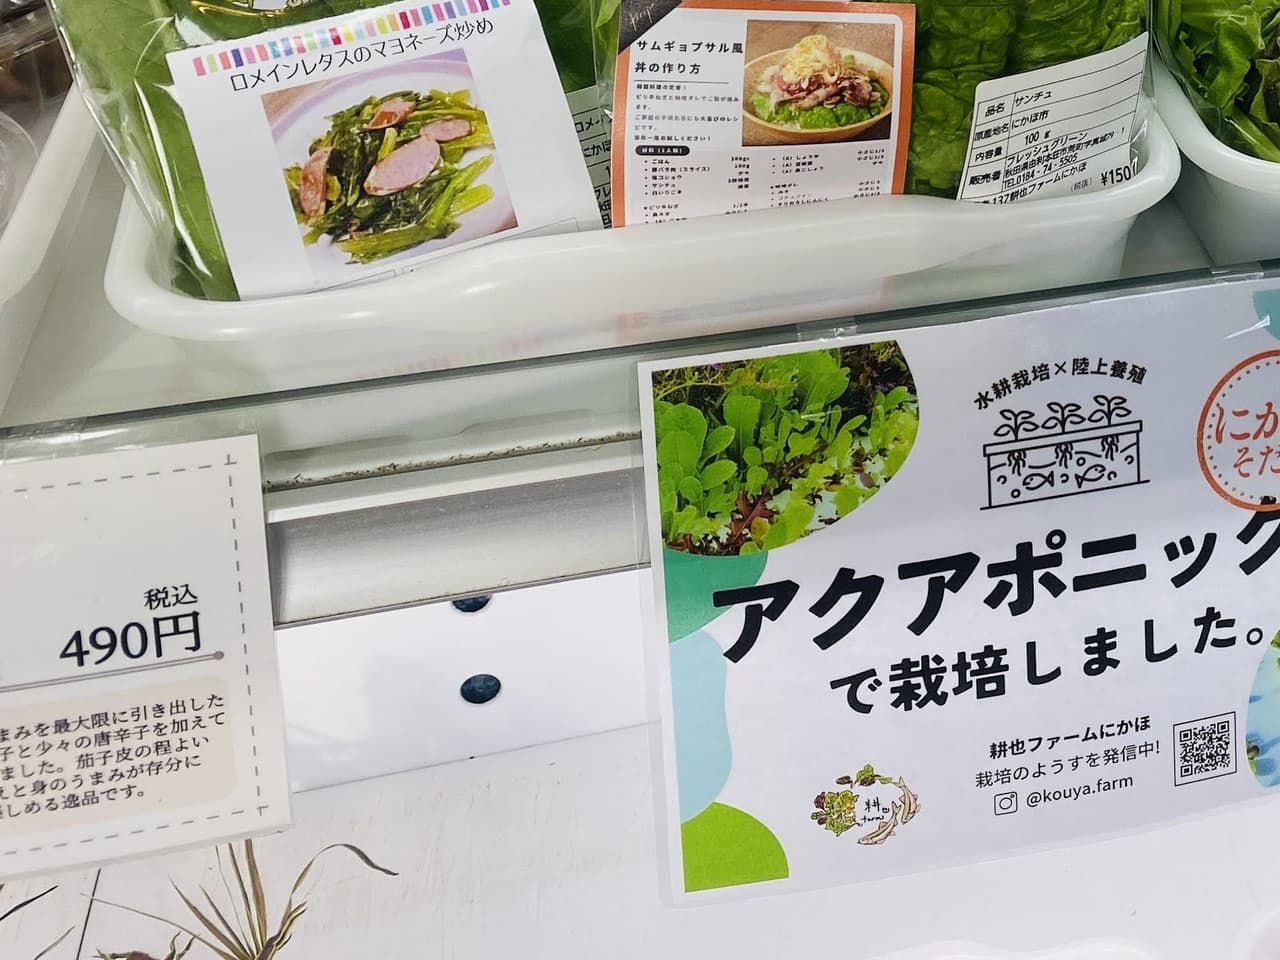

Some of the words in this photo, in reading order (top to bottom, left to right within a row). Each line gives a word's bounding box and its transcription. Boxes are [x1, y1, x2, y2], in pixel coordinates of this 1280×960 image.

[230, 17, 494, 91] ロメインレタスのマヨネーズ炒め
[636, 39, 744, 54] サムギョプサル風
[634, 61, 701, 74] 丼の作り方
[985, 103, 1005, 117] 品名
[1015, 91, 1052, 106] サンチュ
[1012, 110, 1049, 129] にかほ市
[975, 146, 1003, 161] 内容量
[1025, 131, 1040, 146] 100
[1007, 132, 1088, 168] フレッシュグリーン
[969, 171, 1002, 186] 販売者
[973, 357, 1147, 410] 水耕栽培×陸上養殖
[143, 583, 199, 611] 税込
[59, 610, 201, 667] 490円
[830, 605, 1265, 714] で栽培しました。
[989, 715, 1150, 760] 耕也ファームにかほ
[976, 740, 1160, 789] 栽培のようすを発信中!
[0, 784, 145, 819] しめる逸品です。
[1026, 776, 1133, 808] @kouya.farm
